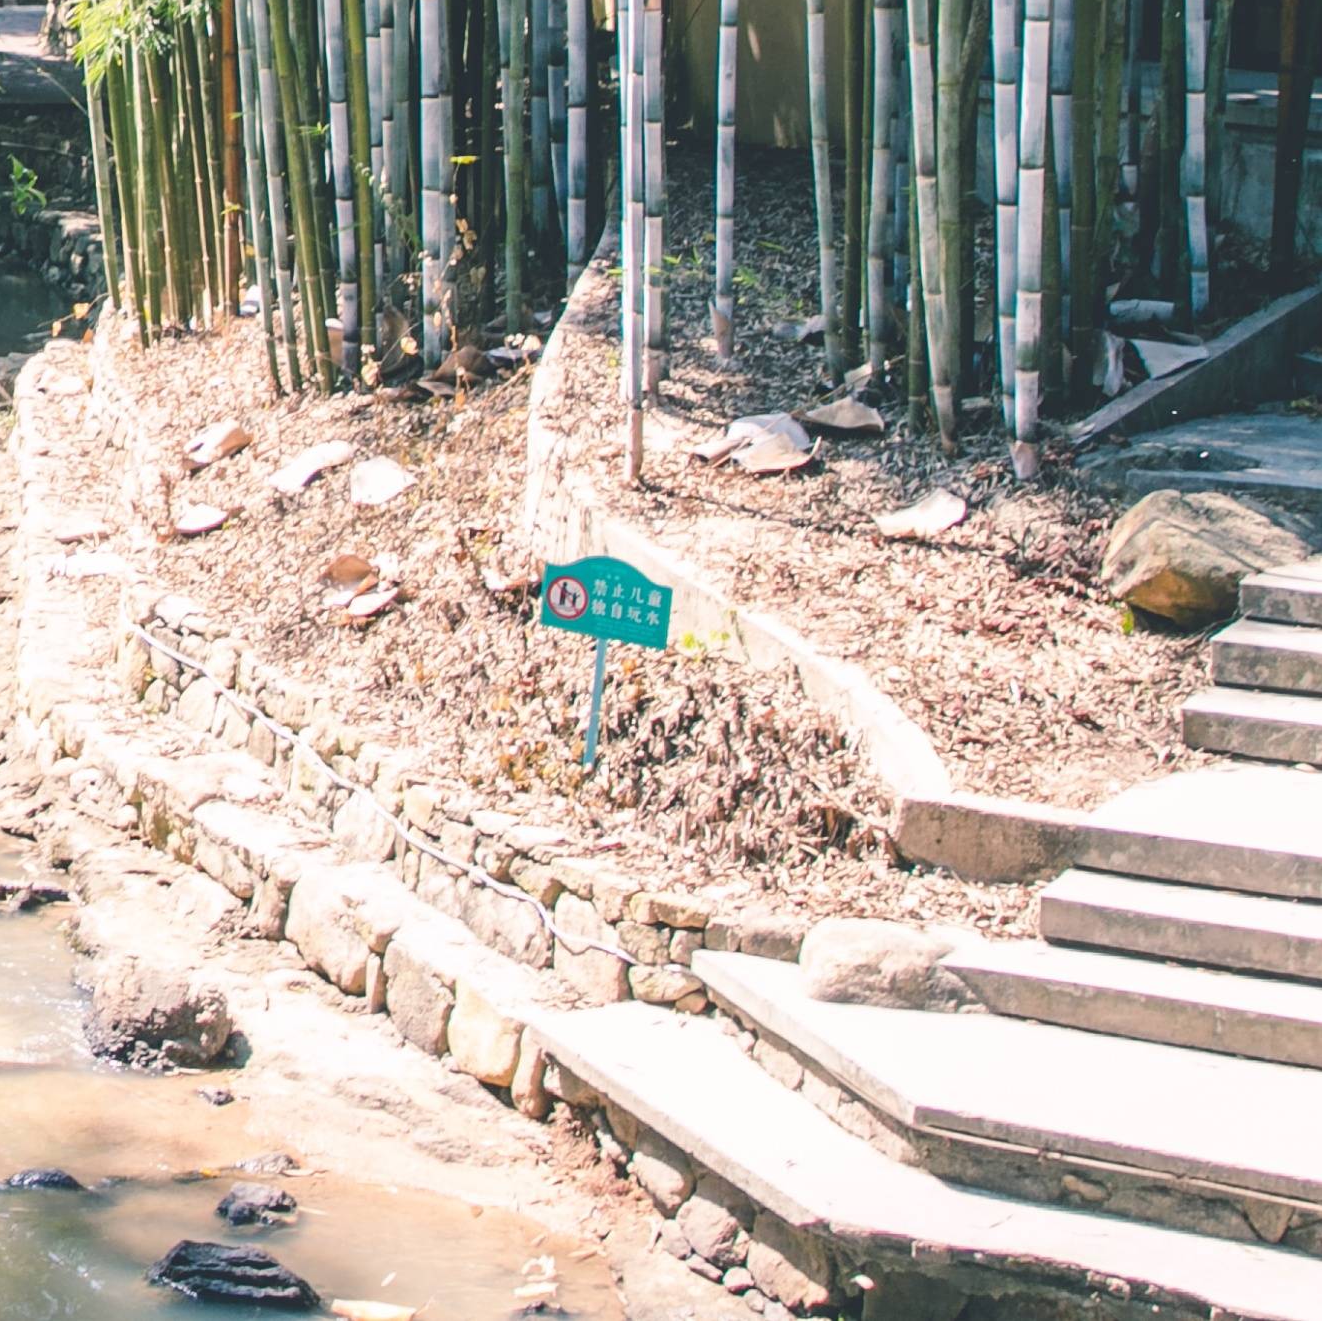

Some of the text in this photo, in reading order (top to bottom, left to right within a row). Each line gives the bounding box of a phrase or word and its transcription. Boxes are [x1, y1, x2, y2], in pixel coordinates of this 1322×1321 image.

[592, 579, 662, 608] 禁止儿童
[591, 599, 660, 626] 独自玩水
